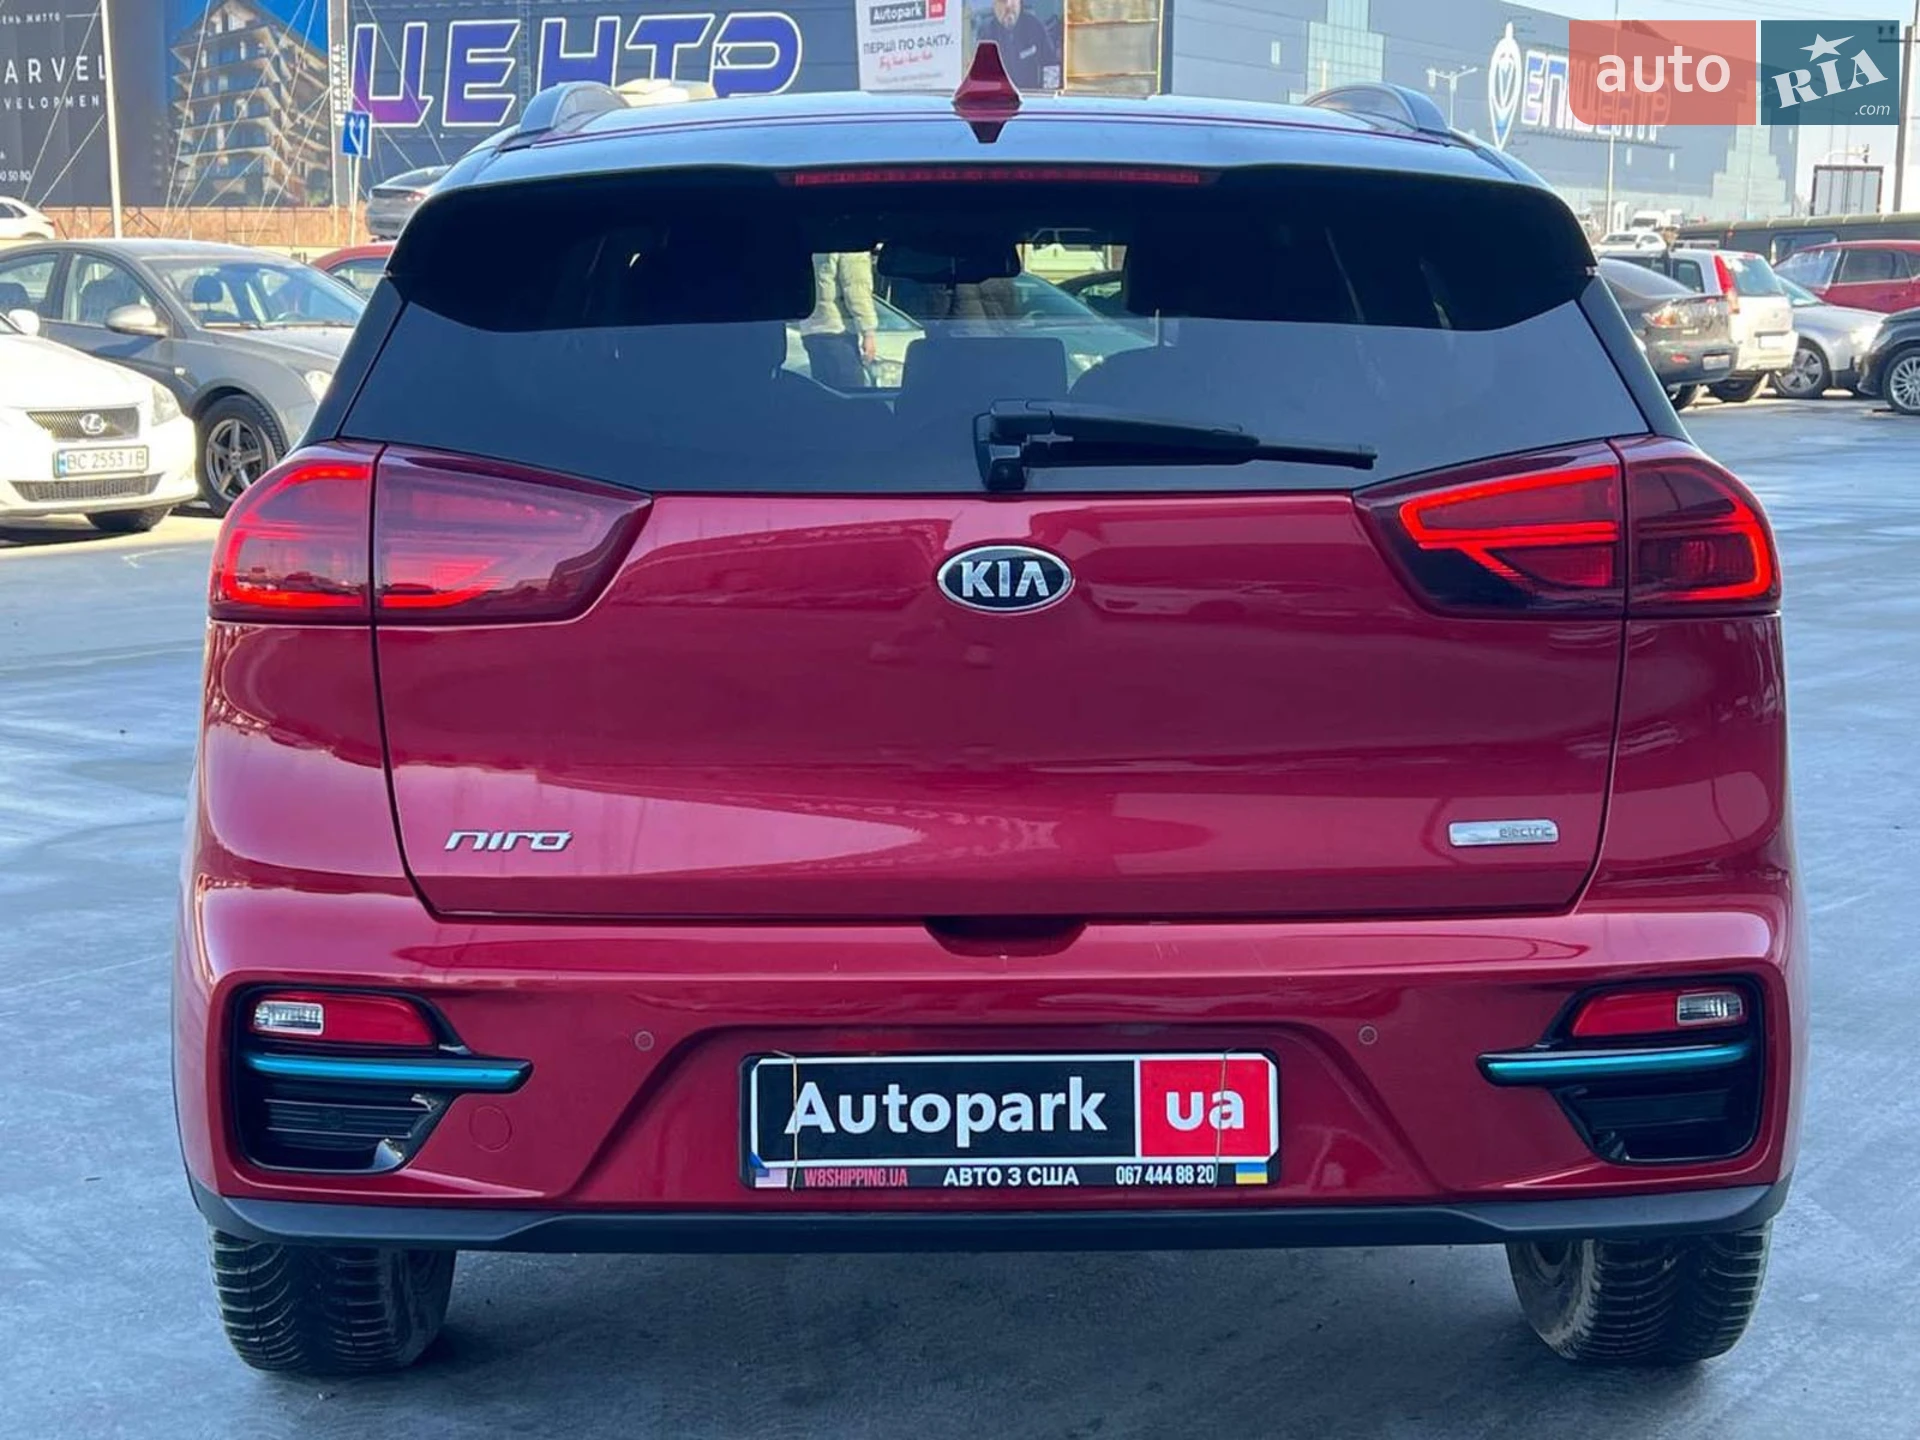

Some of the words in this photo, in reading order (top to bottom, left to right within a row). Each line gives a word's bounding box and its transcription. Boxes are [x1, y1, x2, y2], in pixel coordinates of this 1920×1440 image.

[873, 2, 923, 21] Autopark
[898, 38, 915, 50] ПО
[350, 12, 802, 127] ЦЕНТР
[961, 560, 1050, 597] KIA
[1499, 826, 1554, 838] electric
[784, 1076, 1108, 1148] Autopark
[1165, 1090, 1245, 1131] ua
[803, 1166, 909, 1188] W8SHIPPING.UA
[943, 1166, 1003, 1187] АВТО
[1027, 1165, 1080, 1187] США
[1115, 1165, 1143, 1185] 067
[1144, 1165, 1173, 1185] 444
[1175, 1165, 1195, 1185] 88
[1196, 1165, 1215, 1184] 20
